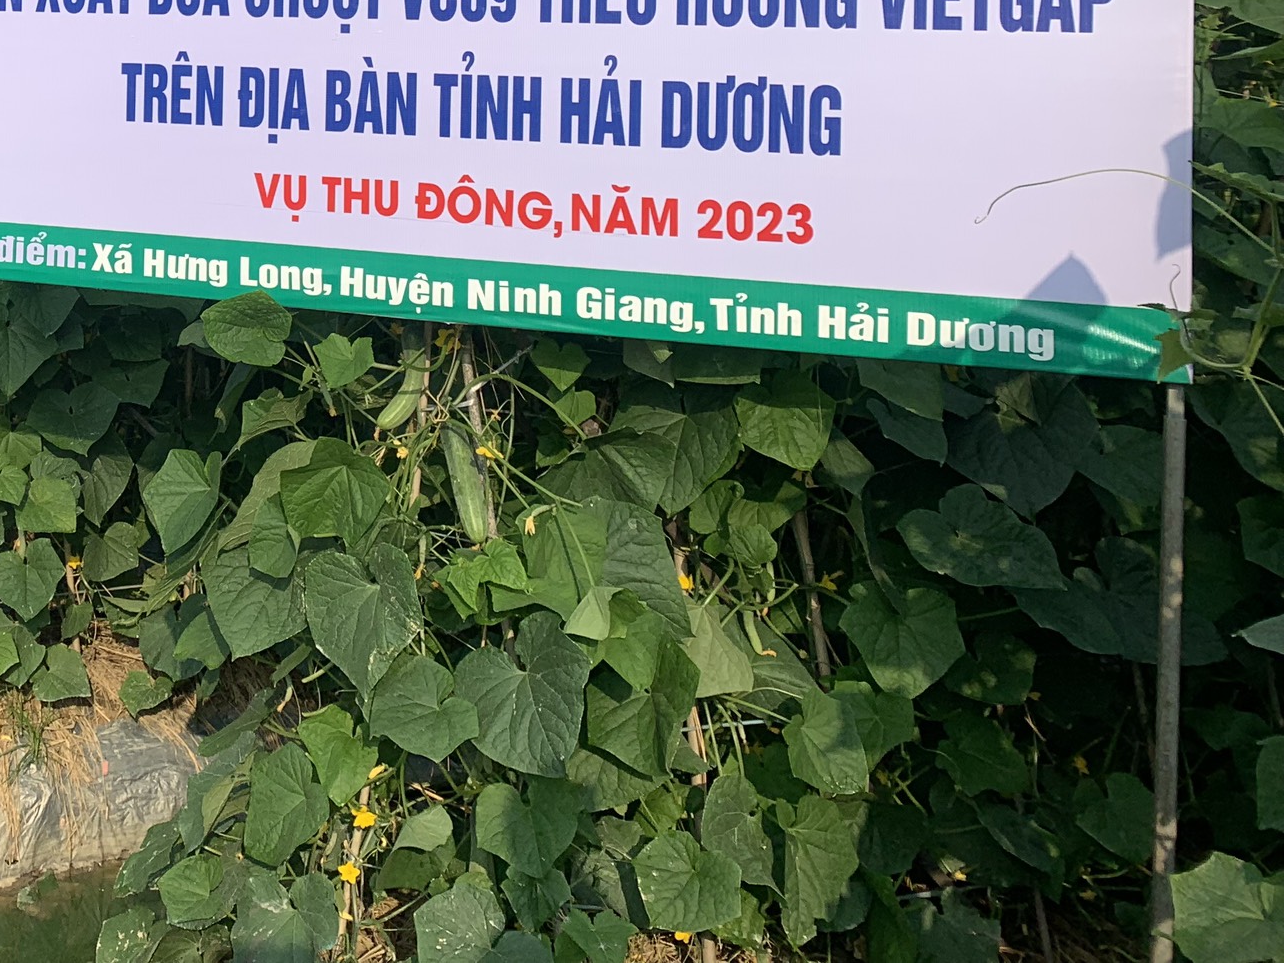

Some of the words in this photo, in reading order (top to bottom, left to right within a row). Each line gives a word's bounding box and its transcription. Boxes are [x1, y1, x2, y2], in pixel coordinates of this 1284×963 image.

[121, 50, 225, 127] TRÊN
[237, 66, 310, 144] ĐỊA
[324, 56, 418, 137] BÀN
[433, 50, 543, 143] TỈNH
[559, 55, 642, 147] HẢI
[660, 75, 842, 157] DƯƠNG
[254, 172, 308, 222] VỤ
[321, 176, 400, 217] THU
[696, 199, 814, 245] 2023
[143, 248, 228, 288] Hưng
[467, 278, 562, 317] Ninh
[817, 302, 890, 344] Hải
[906, 311, 1054, 361] Dương
